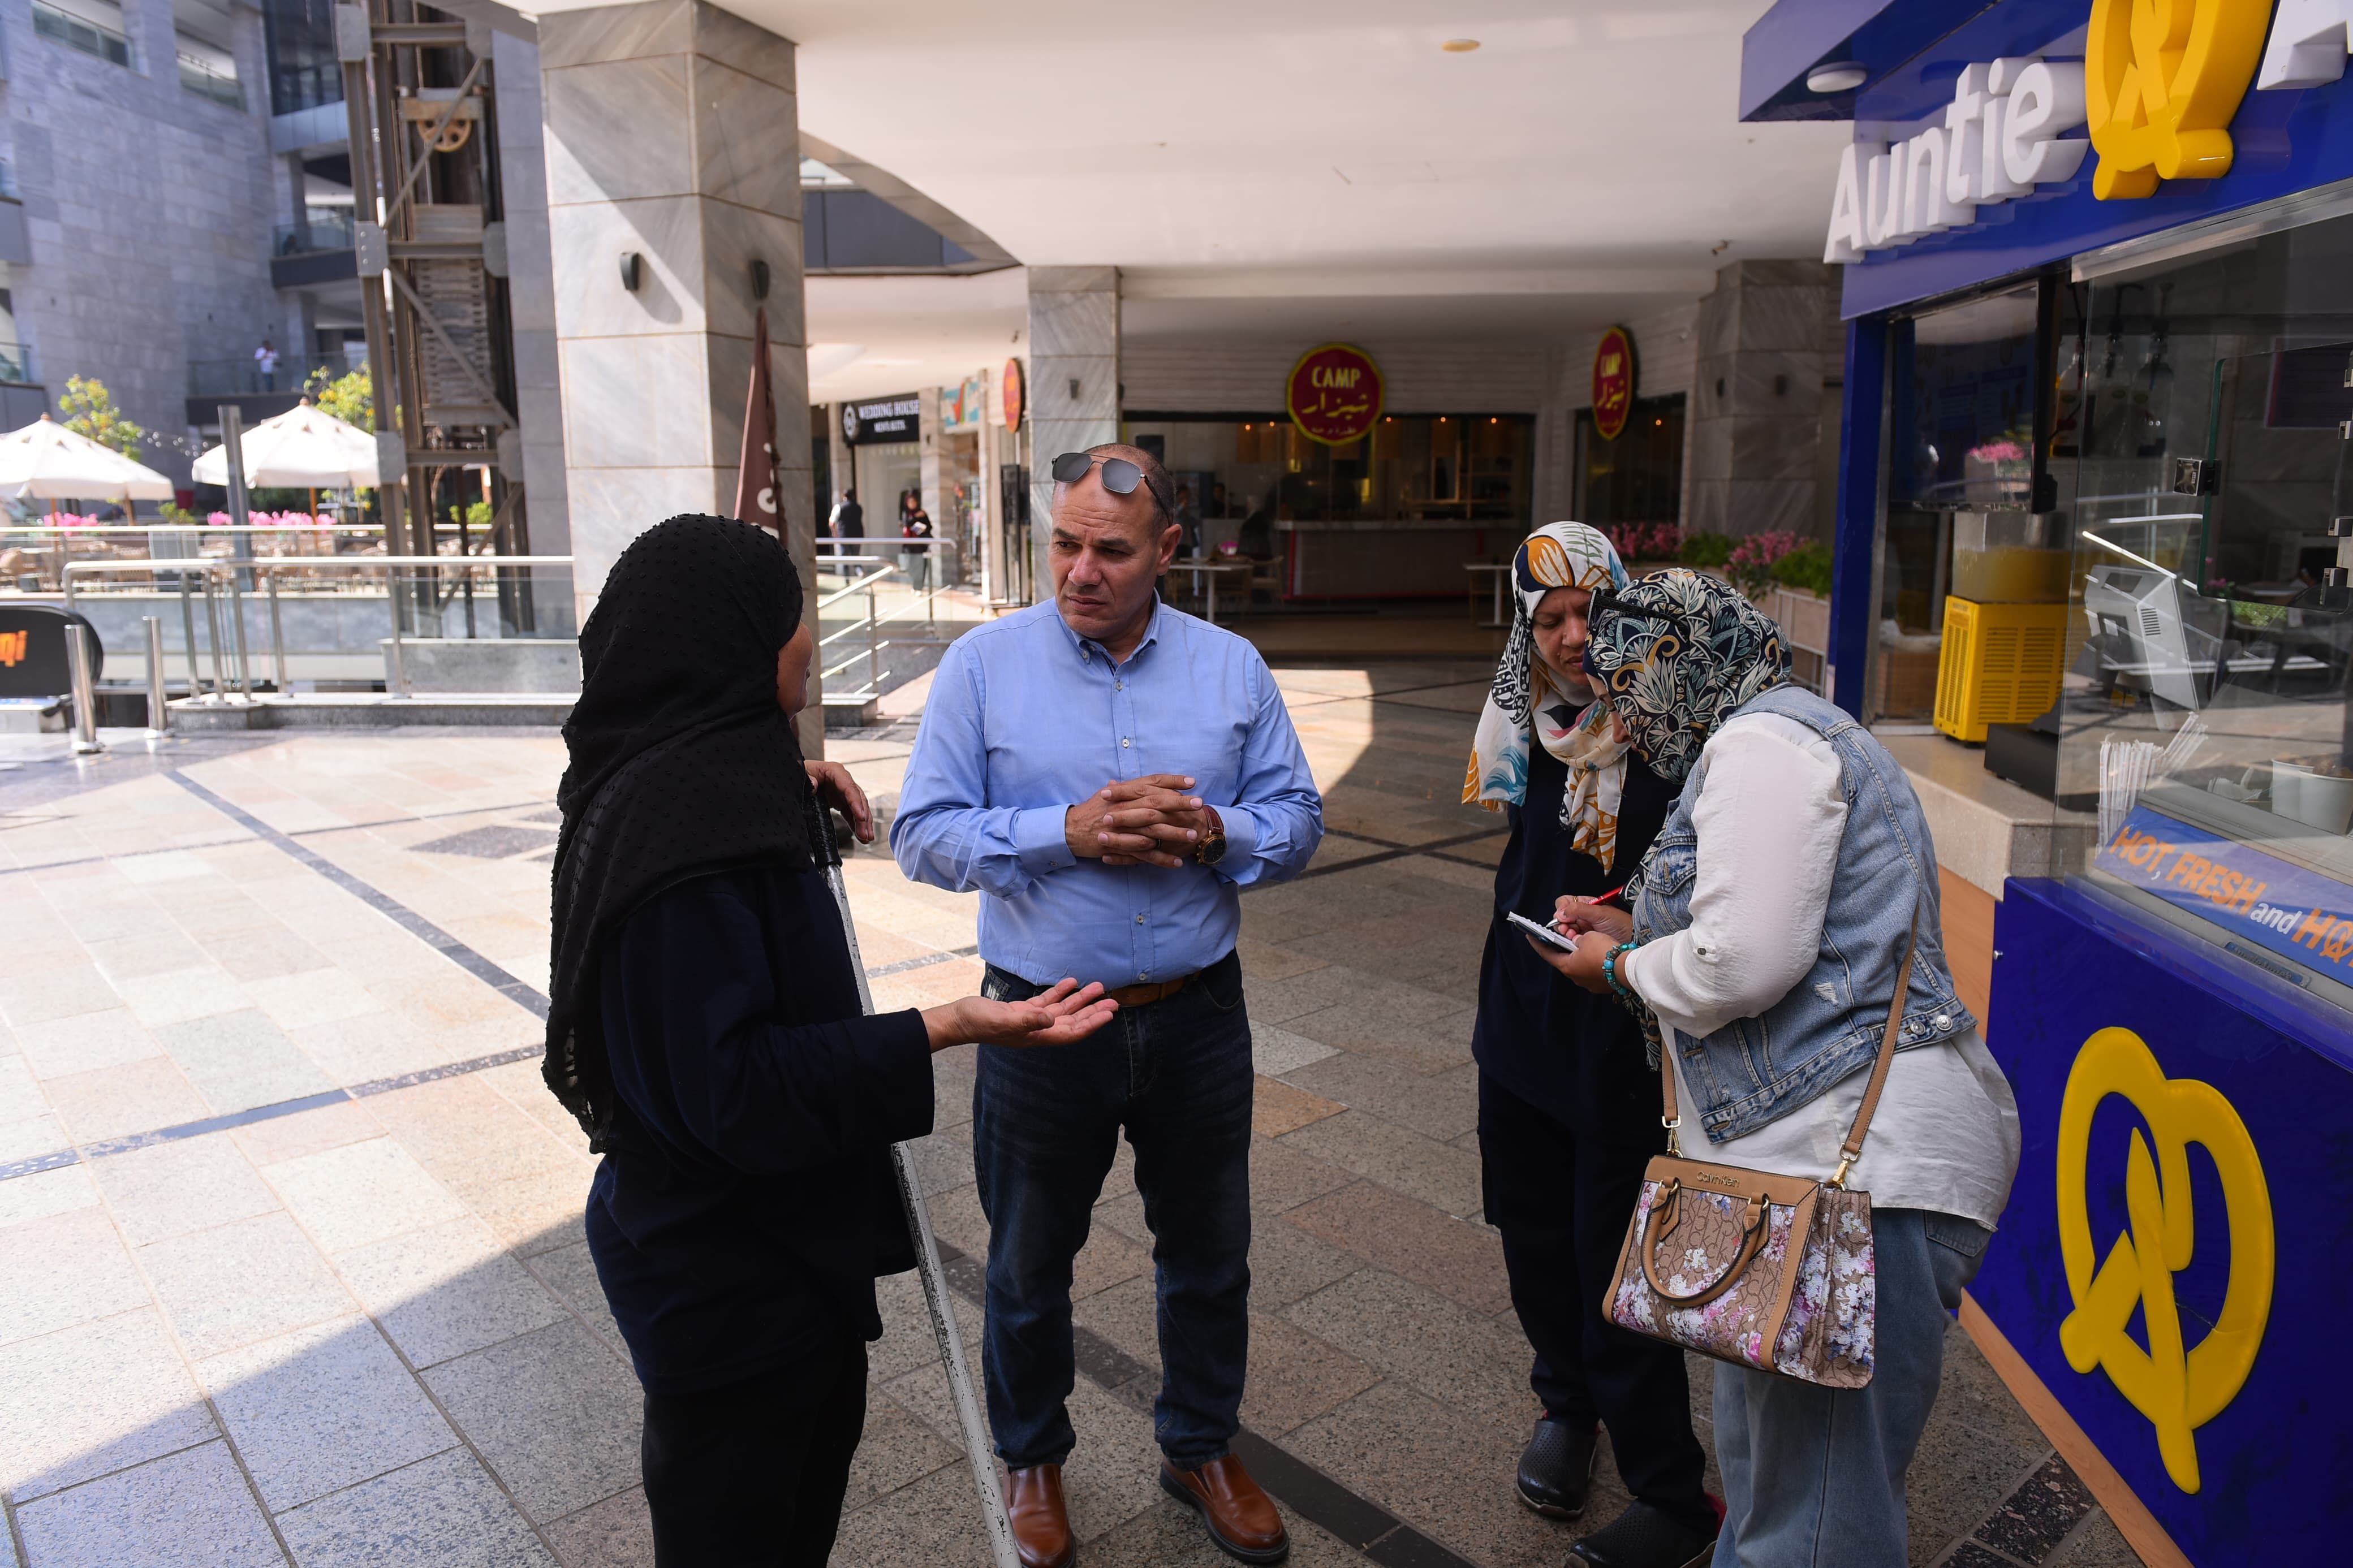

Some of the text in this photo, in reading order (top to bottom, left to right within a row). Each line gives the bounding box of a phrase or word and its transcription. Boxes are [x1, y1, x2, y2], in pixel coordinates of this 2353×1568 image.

[1823, 57, 2092, 264] Auntie
[1311, 366, 1360, 388] CAMP
[858, 399, 920, 420] WEDDING HOUSE
[1302, 392, 1369, 420] شيزار
[2109, 826, 2175, 880] HOT,
[2165, 852, 2267, 915] FRESH
[2250, 902, 2303, 934] and
